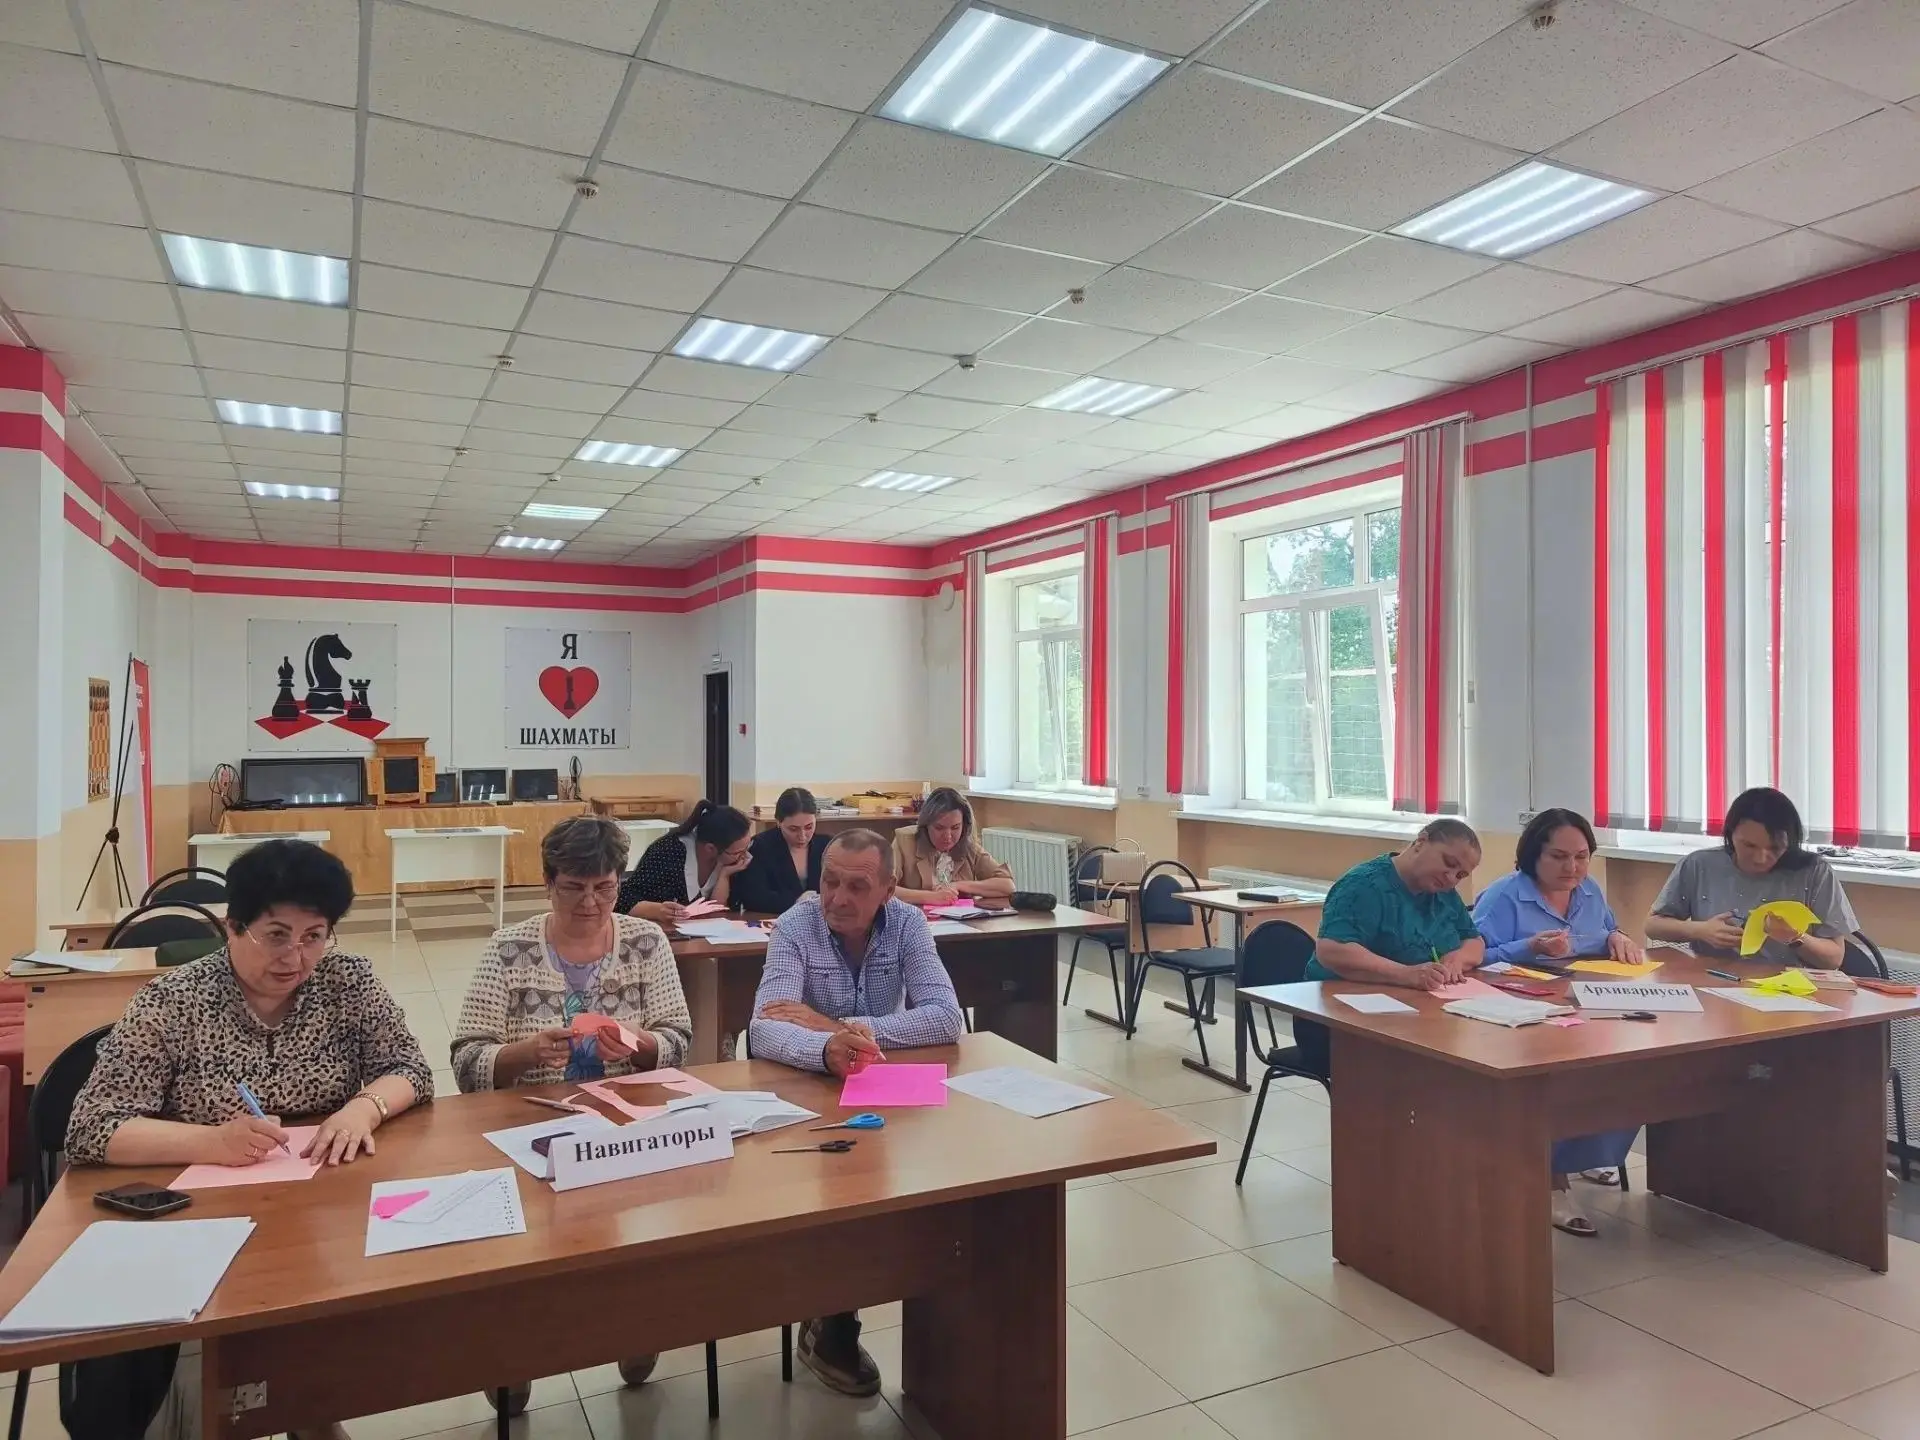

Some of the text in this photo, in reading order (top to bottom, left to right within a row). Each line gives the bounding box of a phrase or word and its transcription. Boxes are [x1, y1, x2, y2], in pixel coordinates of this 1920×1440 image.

[560, 633, 579, 660] Я
[520, 727, 616, 745] ШАХМАТЫ
[1582, 984, 1690, 998] Архивариусы
[574, 1126, 716, 1162] Навигаторы
